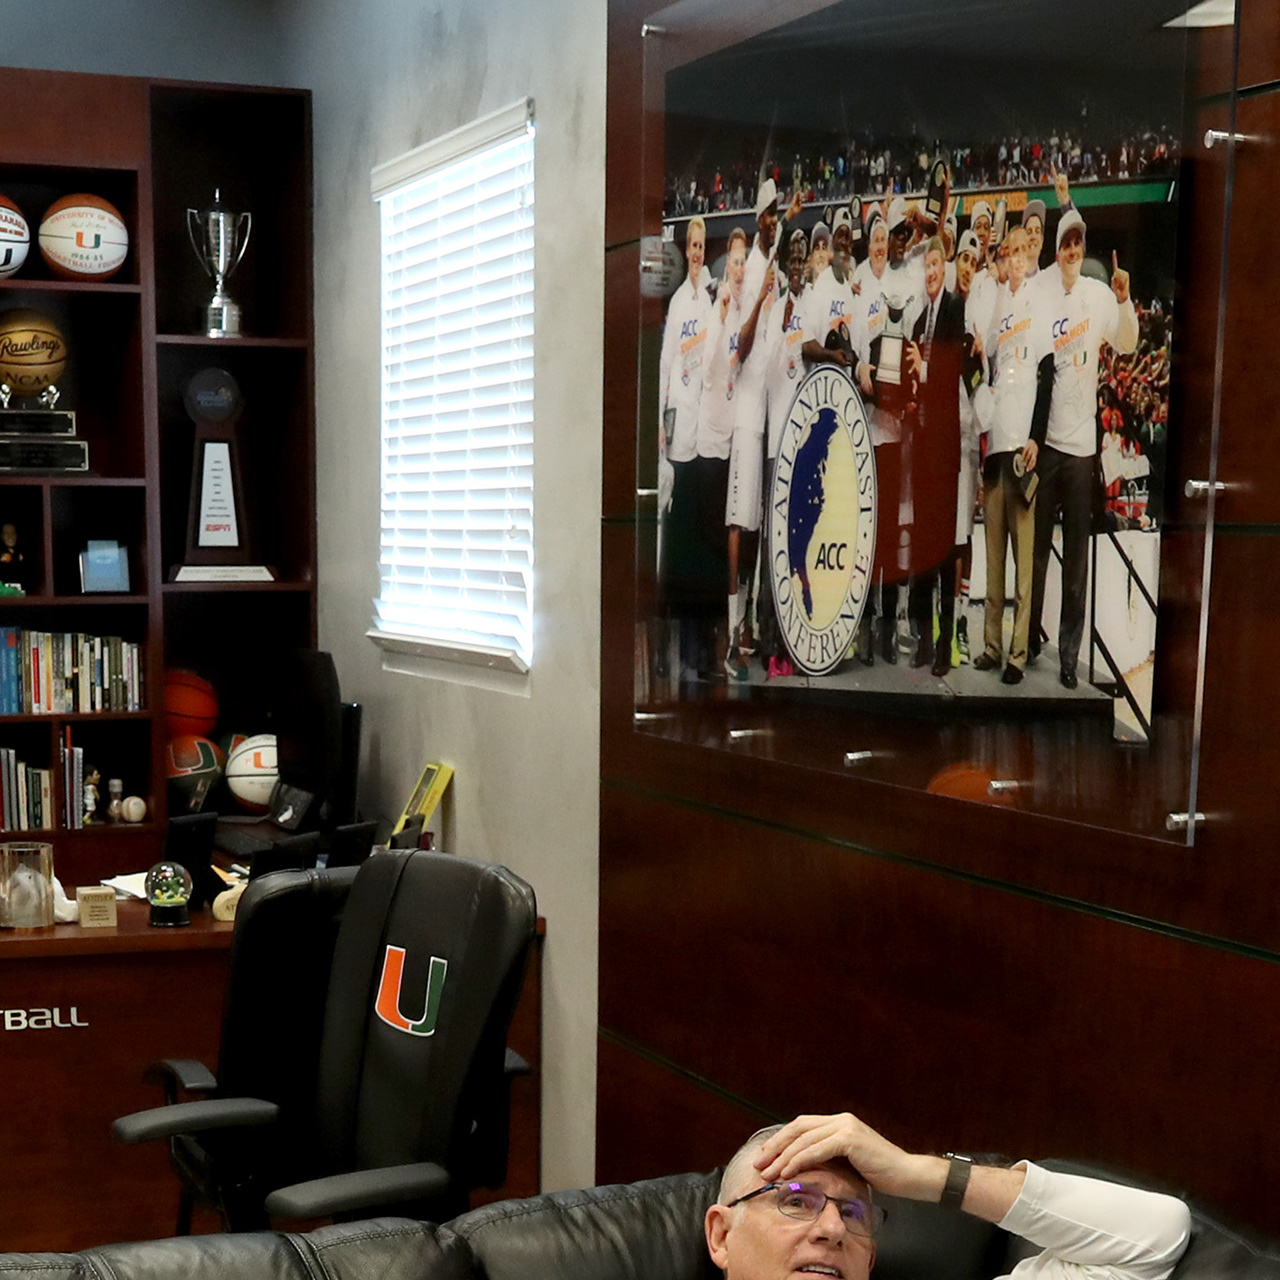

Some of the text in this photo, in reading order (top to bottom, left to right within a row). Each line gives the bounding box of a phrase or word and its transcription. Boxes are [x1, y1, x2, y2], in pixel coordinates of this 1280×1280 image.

[680, 319, 698, 339] ACC
[829, 301, 845, 317] ACC
[774, 376, 873, 523] ATLANTIC COAST
[815, 543, 847, 570] ACC
[774, 549, 869, 664] CONFERENCE
[375, 944, 448, 1037] U
